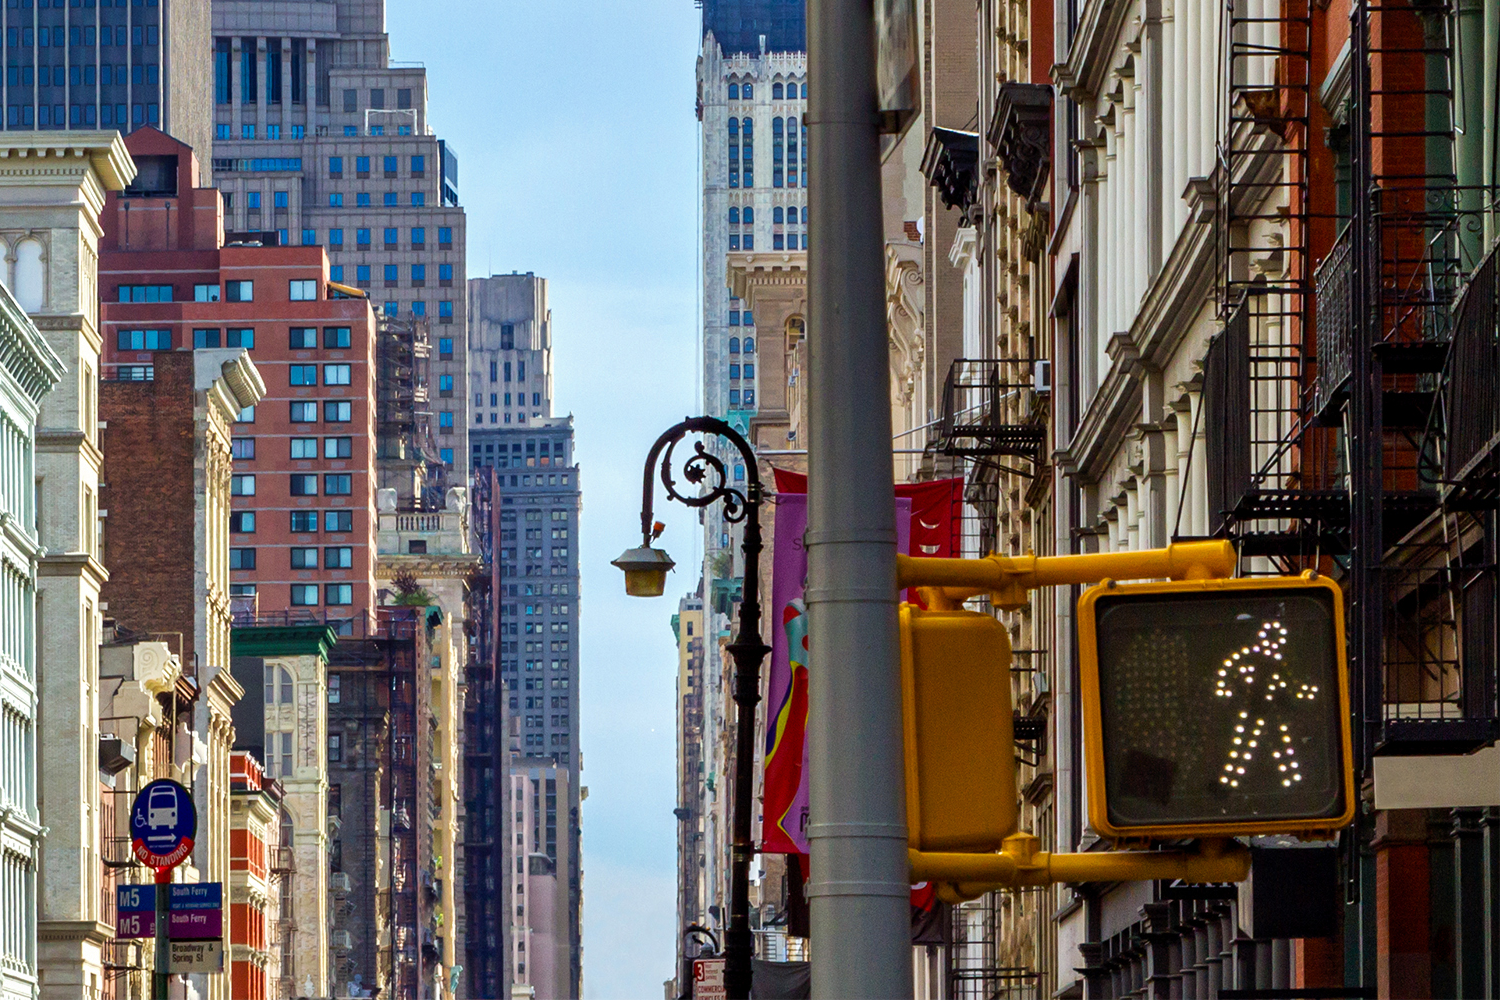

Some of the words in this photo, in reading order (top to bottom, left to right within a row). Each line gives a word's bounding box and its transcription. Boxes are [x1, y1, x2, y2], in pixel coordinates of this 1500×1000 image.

[137, 845, 148, 859] NO
[150, 843, 188, 866] STANDING
[120, 888, 140, 907] M5
[172, 886, 190, 897] South
[191, 886, 208, 898] Ferry
[120, 915, 140, 935] M5
[171, 914, 189, 924] South
[190, 913, 207, 925] Ferry
[172, 944, 204, 954] Broadway
[208, 943, 214, 952] &
[172, 953, 194, 964] Spring
[196, 953, 204, 962] St
[697, 963, 703, 980] 3
